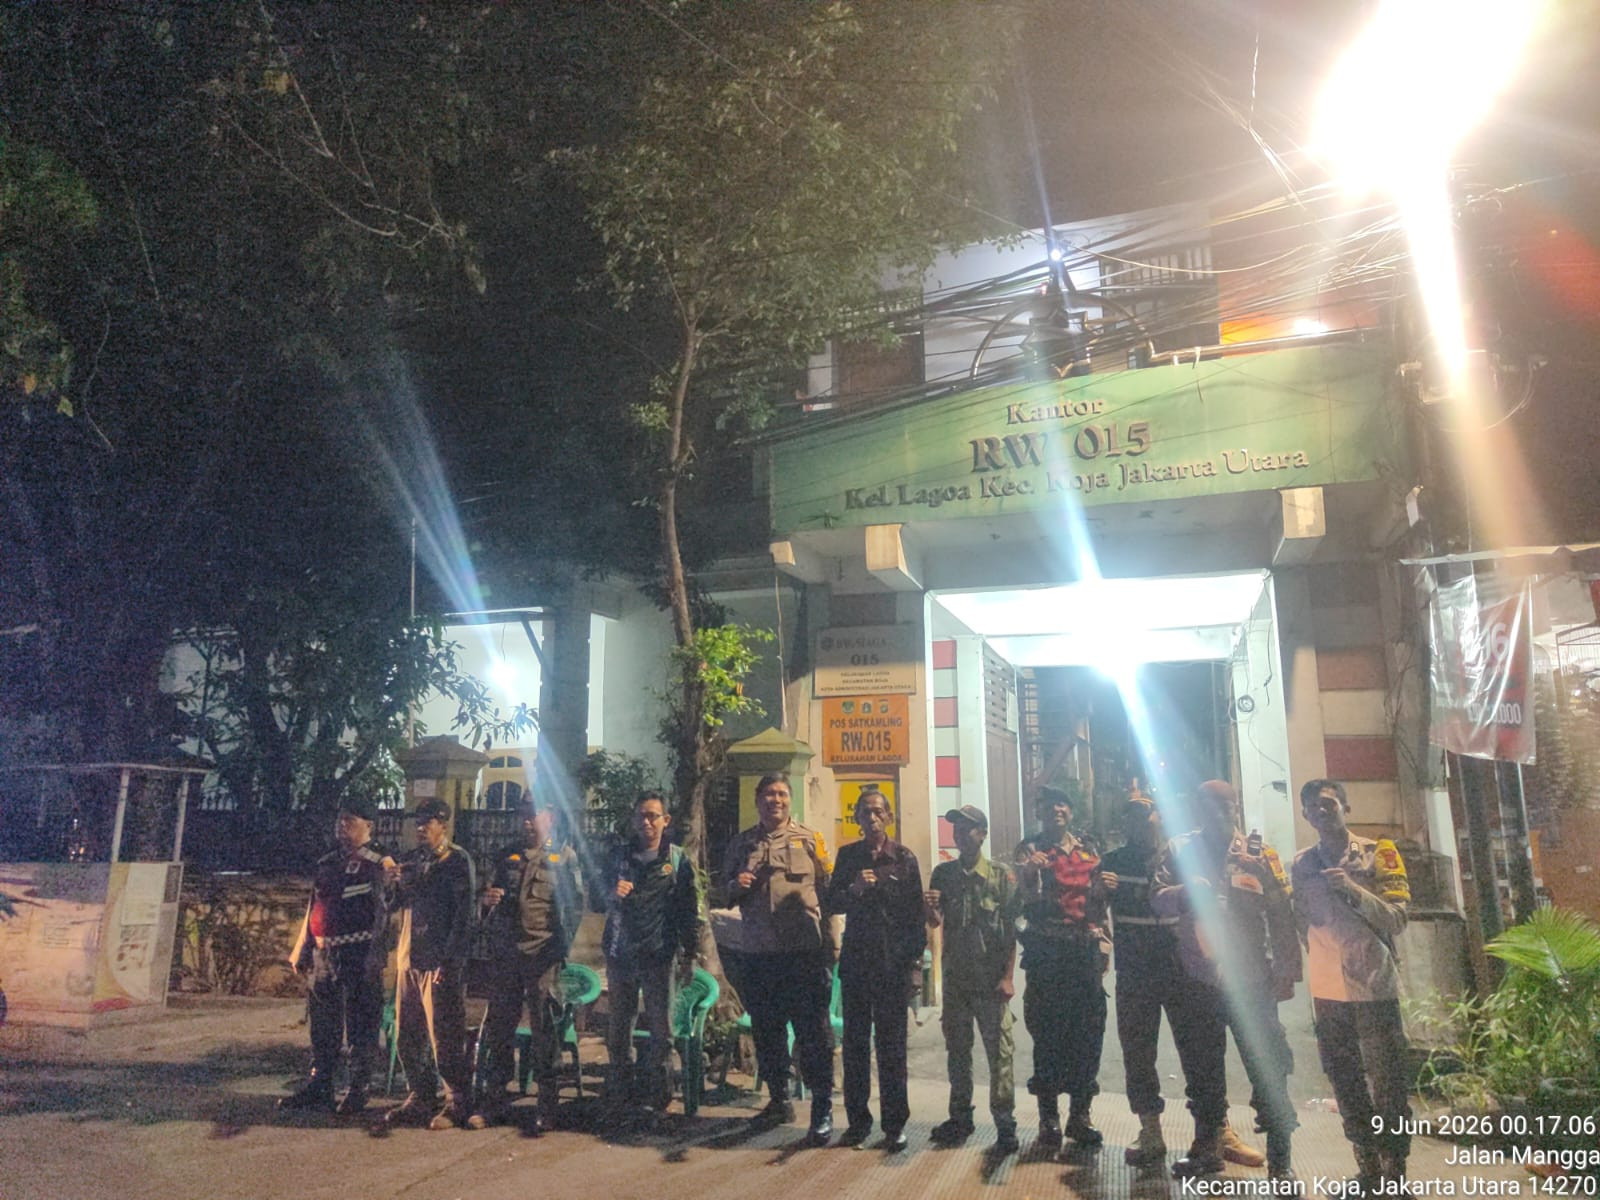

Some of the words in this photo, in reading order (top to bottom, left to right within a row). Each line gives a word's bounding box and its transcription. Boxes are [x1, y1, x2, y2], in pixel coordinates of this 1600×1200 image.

[1007, 399, 1106, 425] Kantor
[969, 431, 1049, 473] RW
[1074, 421, 1151, 460] 015
[896, 483, 971, 507] Lagoa
[980, 475, 1035, 498] Kec.
[1047, 471, 1110, 494] Koja
[1118, 460, 1217, 490] Jakarta
[1222, 448, 1309, 474] Utara
[851, 653, 880, 666] 015
[830, 718, 845, 729] POS
[848, 716, 903, 728] SATKAMLING
[842, 730, 892, 752] RW.015
